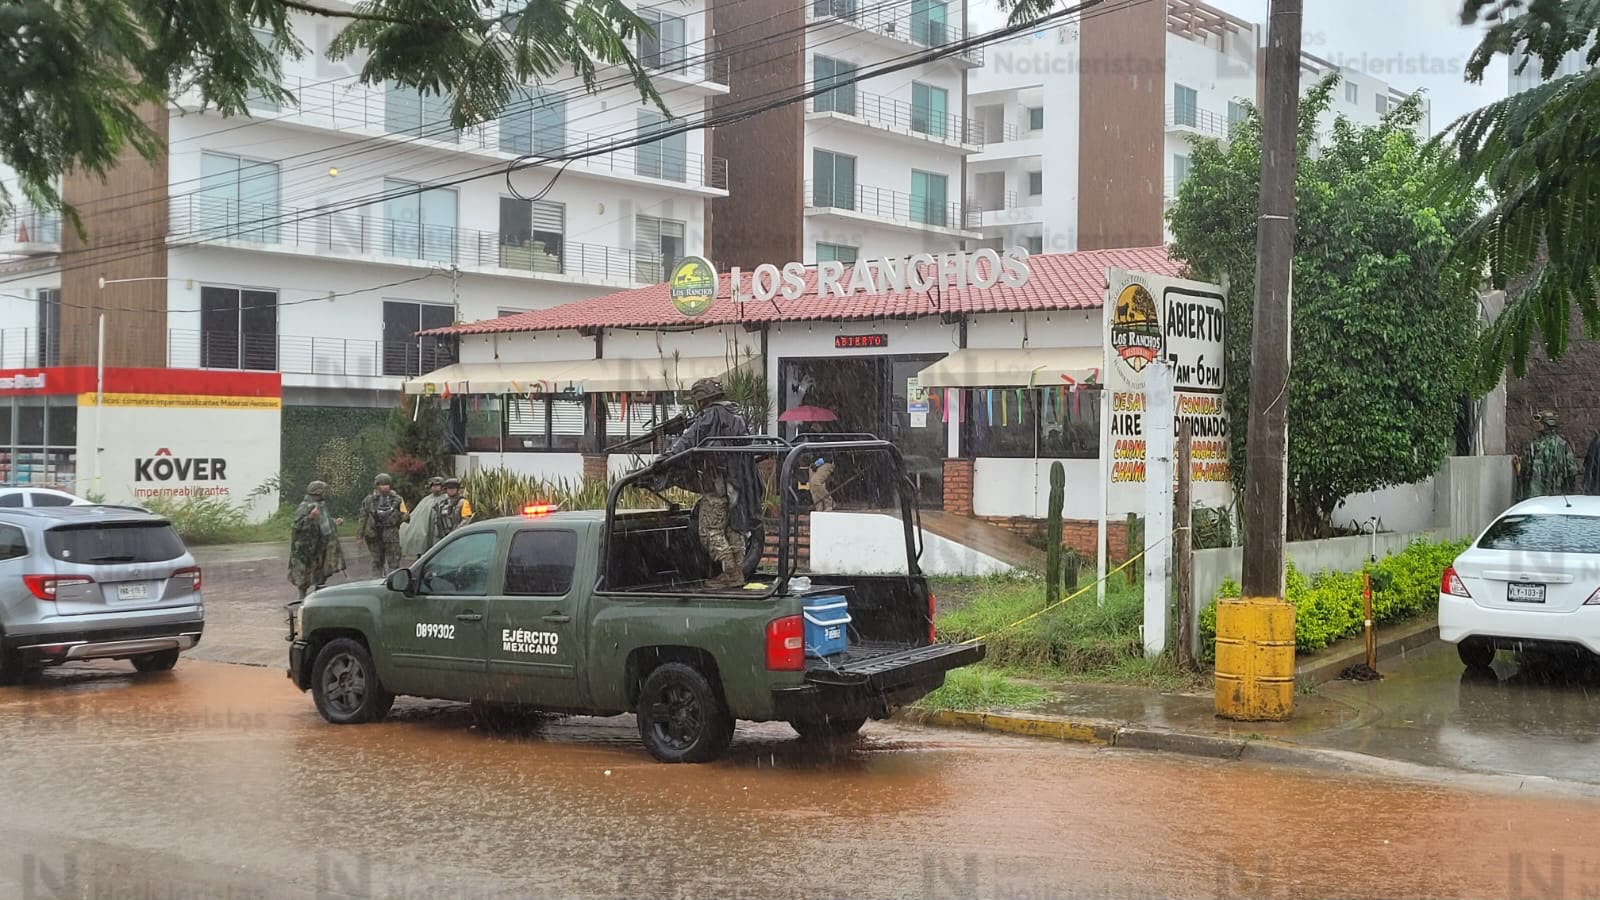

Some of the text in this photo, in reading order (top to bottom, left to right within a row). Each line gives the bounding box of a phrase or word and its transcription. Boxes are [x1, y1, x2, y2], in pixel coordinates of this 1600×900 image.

[731, 246, 1031, 304] LOS RANCHOS
[1167, 299, 1223, 343] ABIERTO
[834, 335, 881, 347] ABIERTO
[1111, 413, 1143, 437] AIRE
[416, 622, 455, 640] 0899302
[502, 627, 559, 645] EJÉRCITO
[503, 642, 558, 655] MEXICANO
